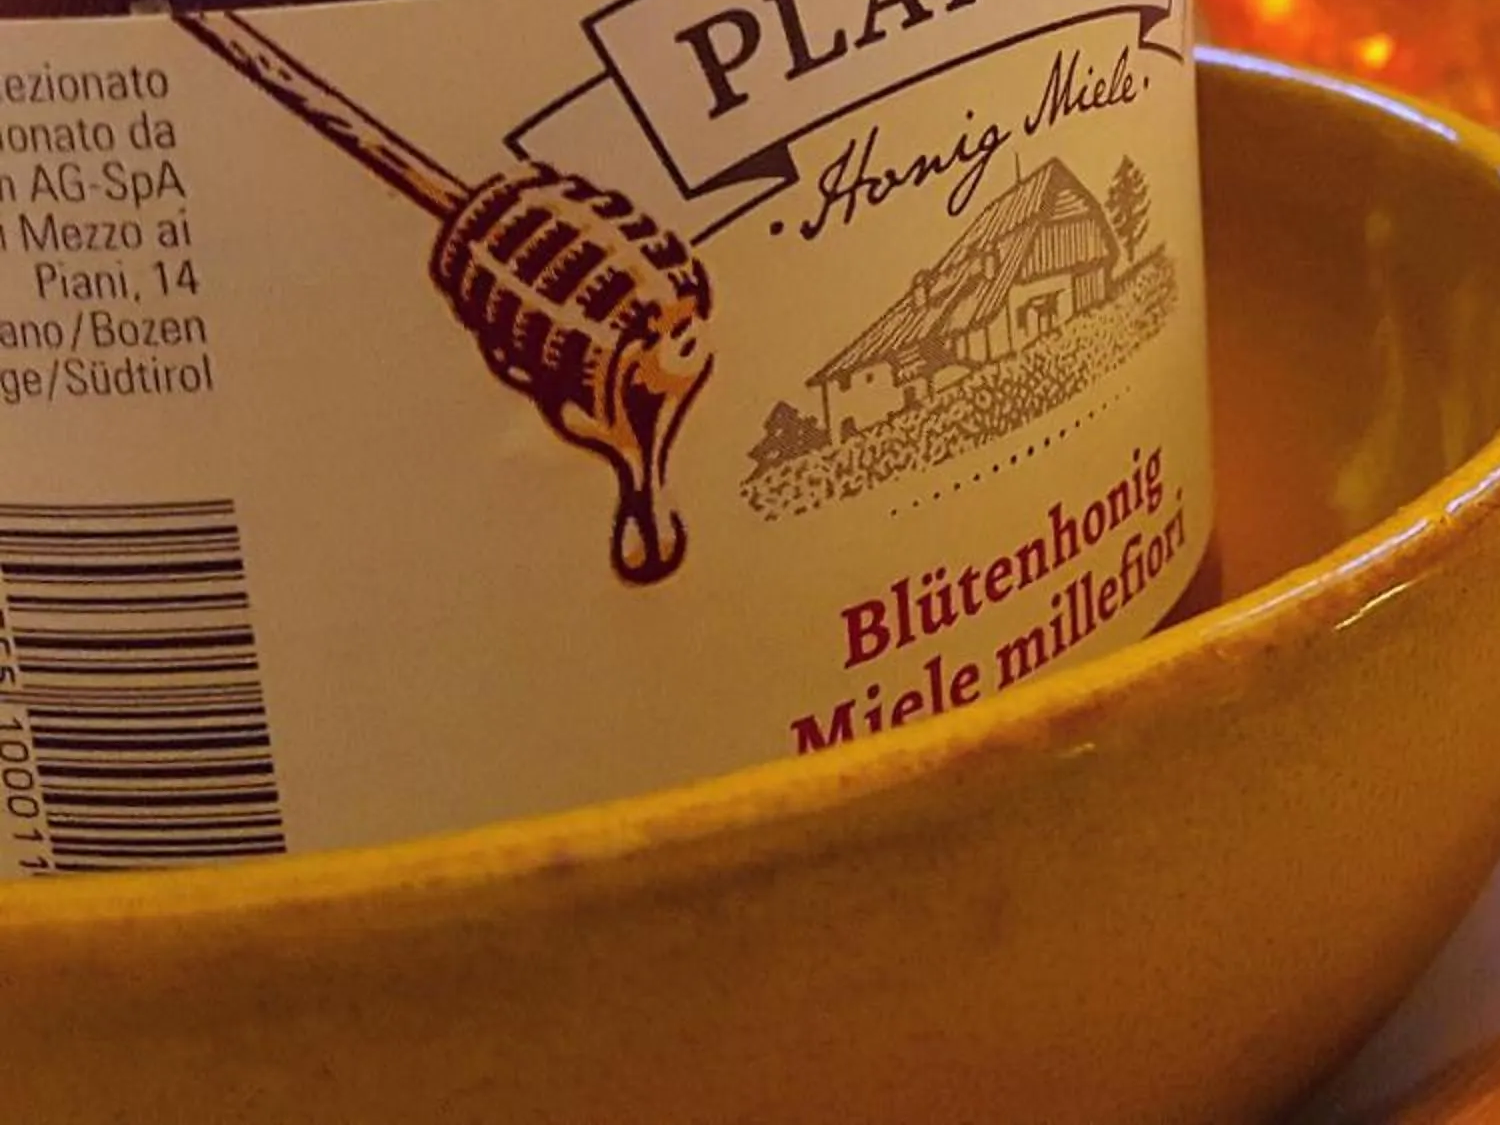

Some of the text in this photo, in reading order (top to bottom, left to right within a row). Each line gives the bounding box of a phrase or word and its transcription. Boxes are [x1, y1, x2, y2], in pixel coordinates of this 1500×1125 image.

[0, 60, 169, 104] ezionato
[129, 110, 176, 151] da
[800, 45, 1136, 241] Honig Miele
[31, 160, 186, 209] AG-SpA
[18, 212, 143, 252] Mezzo
[157, 208, 192, 248] ai
[34, 259, 200, 303] Piani, 14
[840, 446, 1163, 670] Blütenhonig
[790, 486, 1186, 755] Miele millefiori
